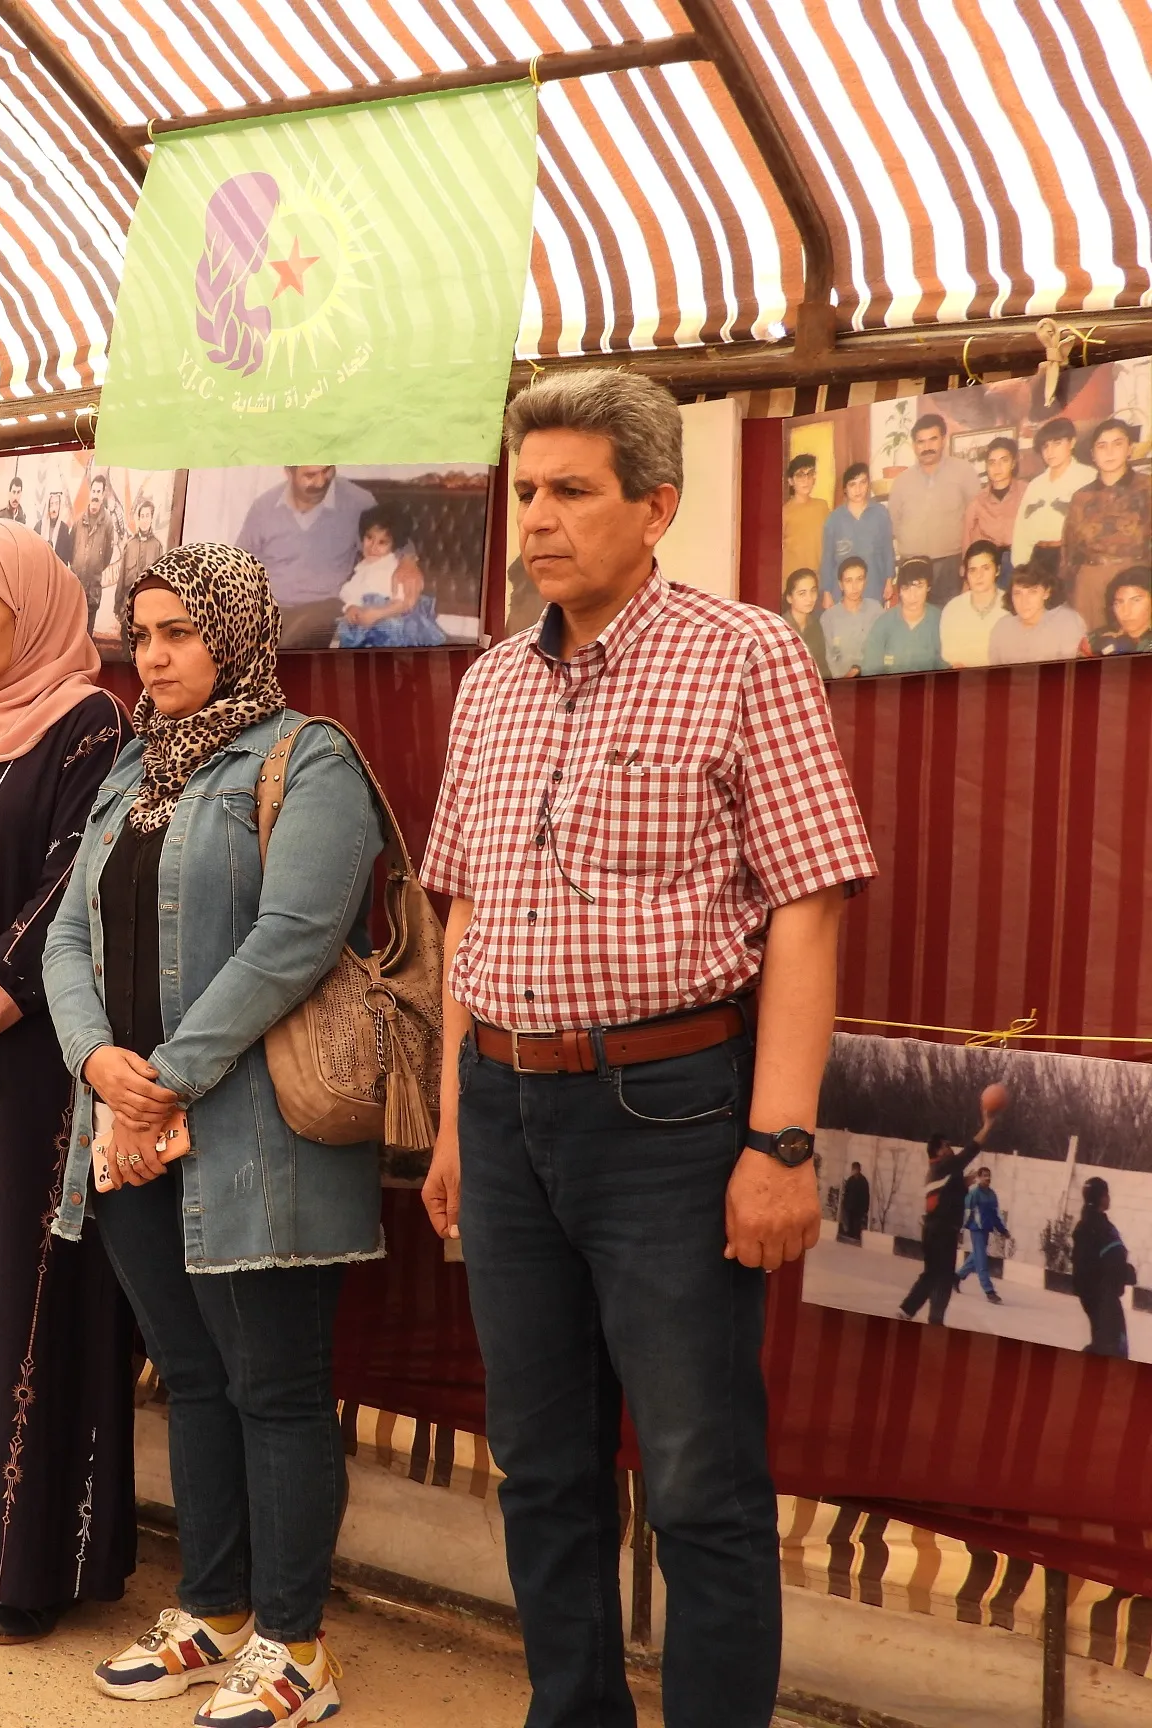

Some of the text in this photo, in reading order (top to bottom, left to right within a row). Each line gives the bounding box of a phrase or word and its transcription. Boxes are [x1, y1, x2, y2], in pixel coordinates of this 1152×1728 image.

[232, 341, 374, 420] اتحاد المرأة الشابة
